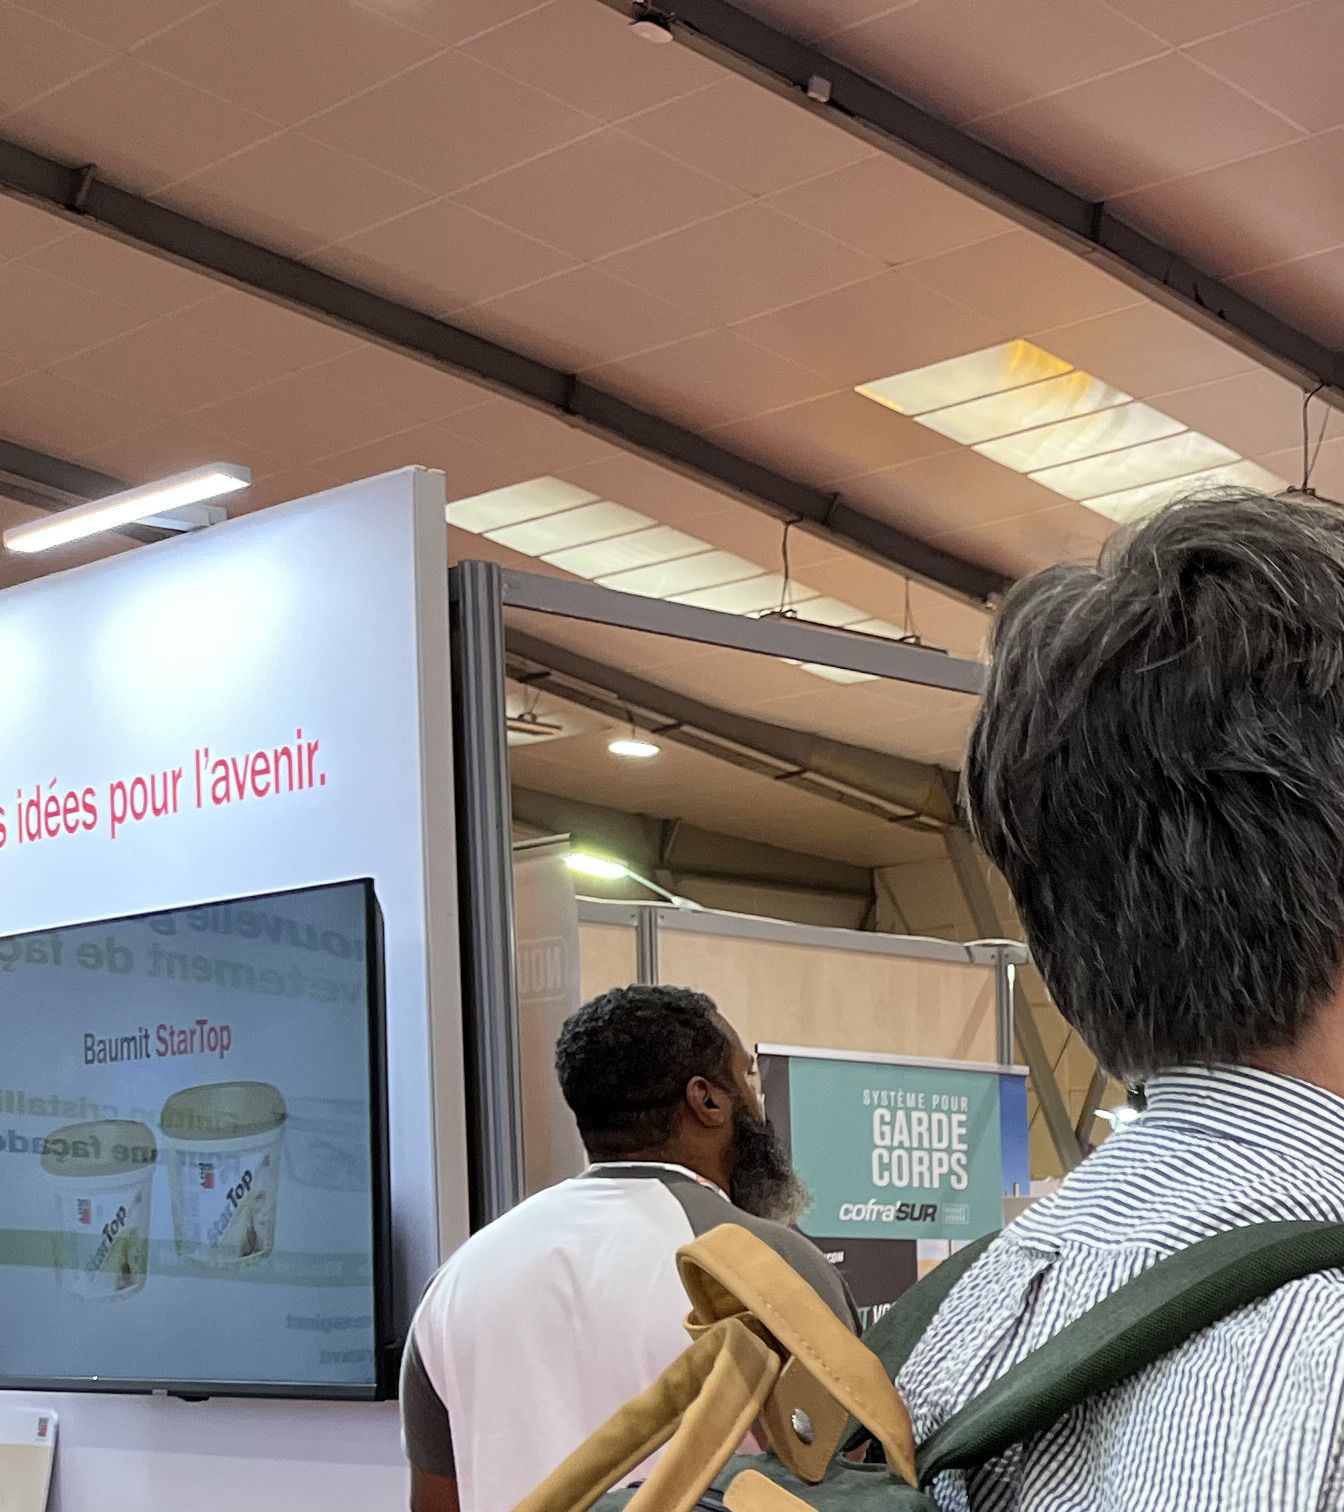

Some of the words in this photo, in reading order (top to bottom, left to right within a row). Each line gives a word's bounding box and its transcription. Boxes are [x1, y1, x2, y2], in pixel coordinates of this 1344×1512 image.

[17, 777, 98, 844] idées
[109, 767, 184, 840] pour
[195, 728, 327, 809] l'avenir.
[84, 1027, 151, 1065] Baumit
[156, 1019, 232, 1059] StarTop
[863, 1088, 925, 1110] SYSTÈME
[932, 1095, 968, 1111] POUR
[873, 1107, 968, 1151] GARDE
[872, 1148, 968, 1190] CORPS
